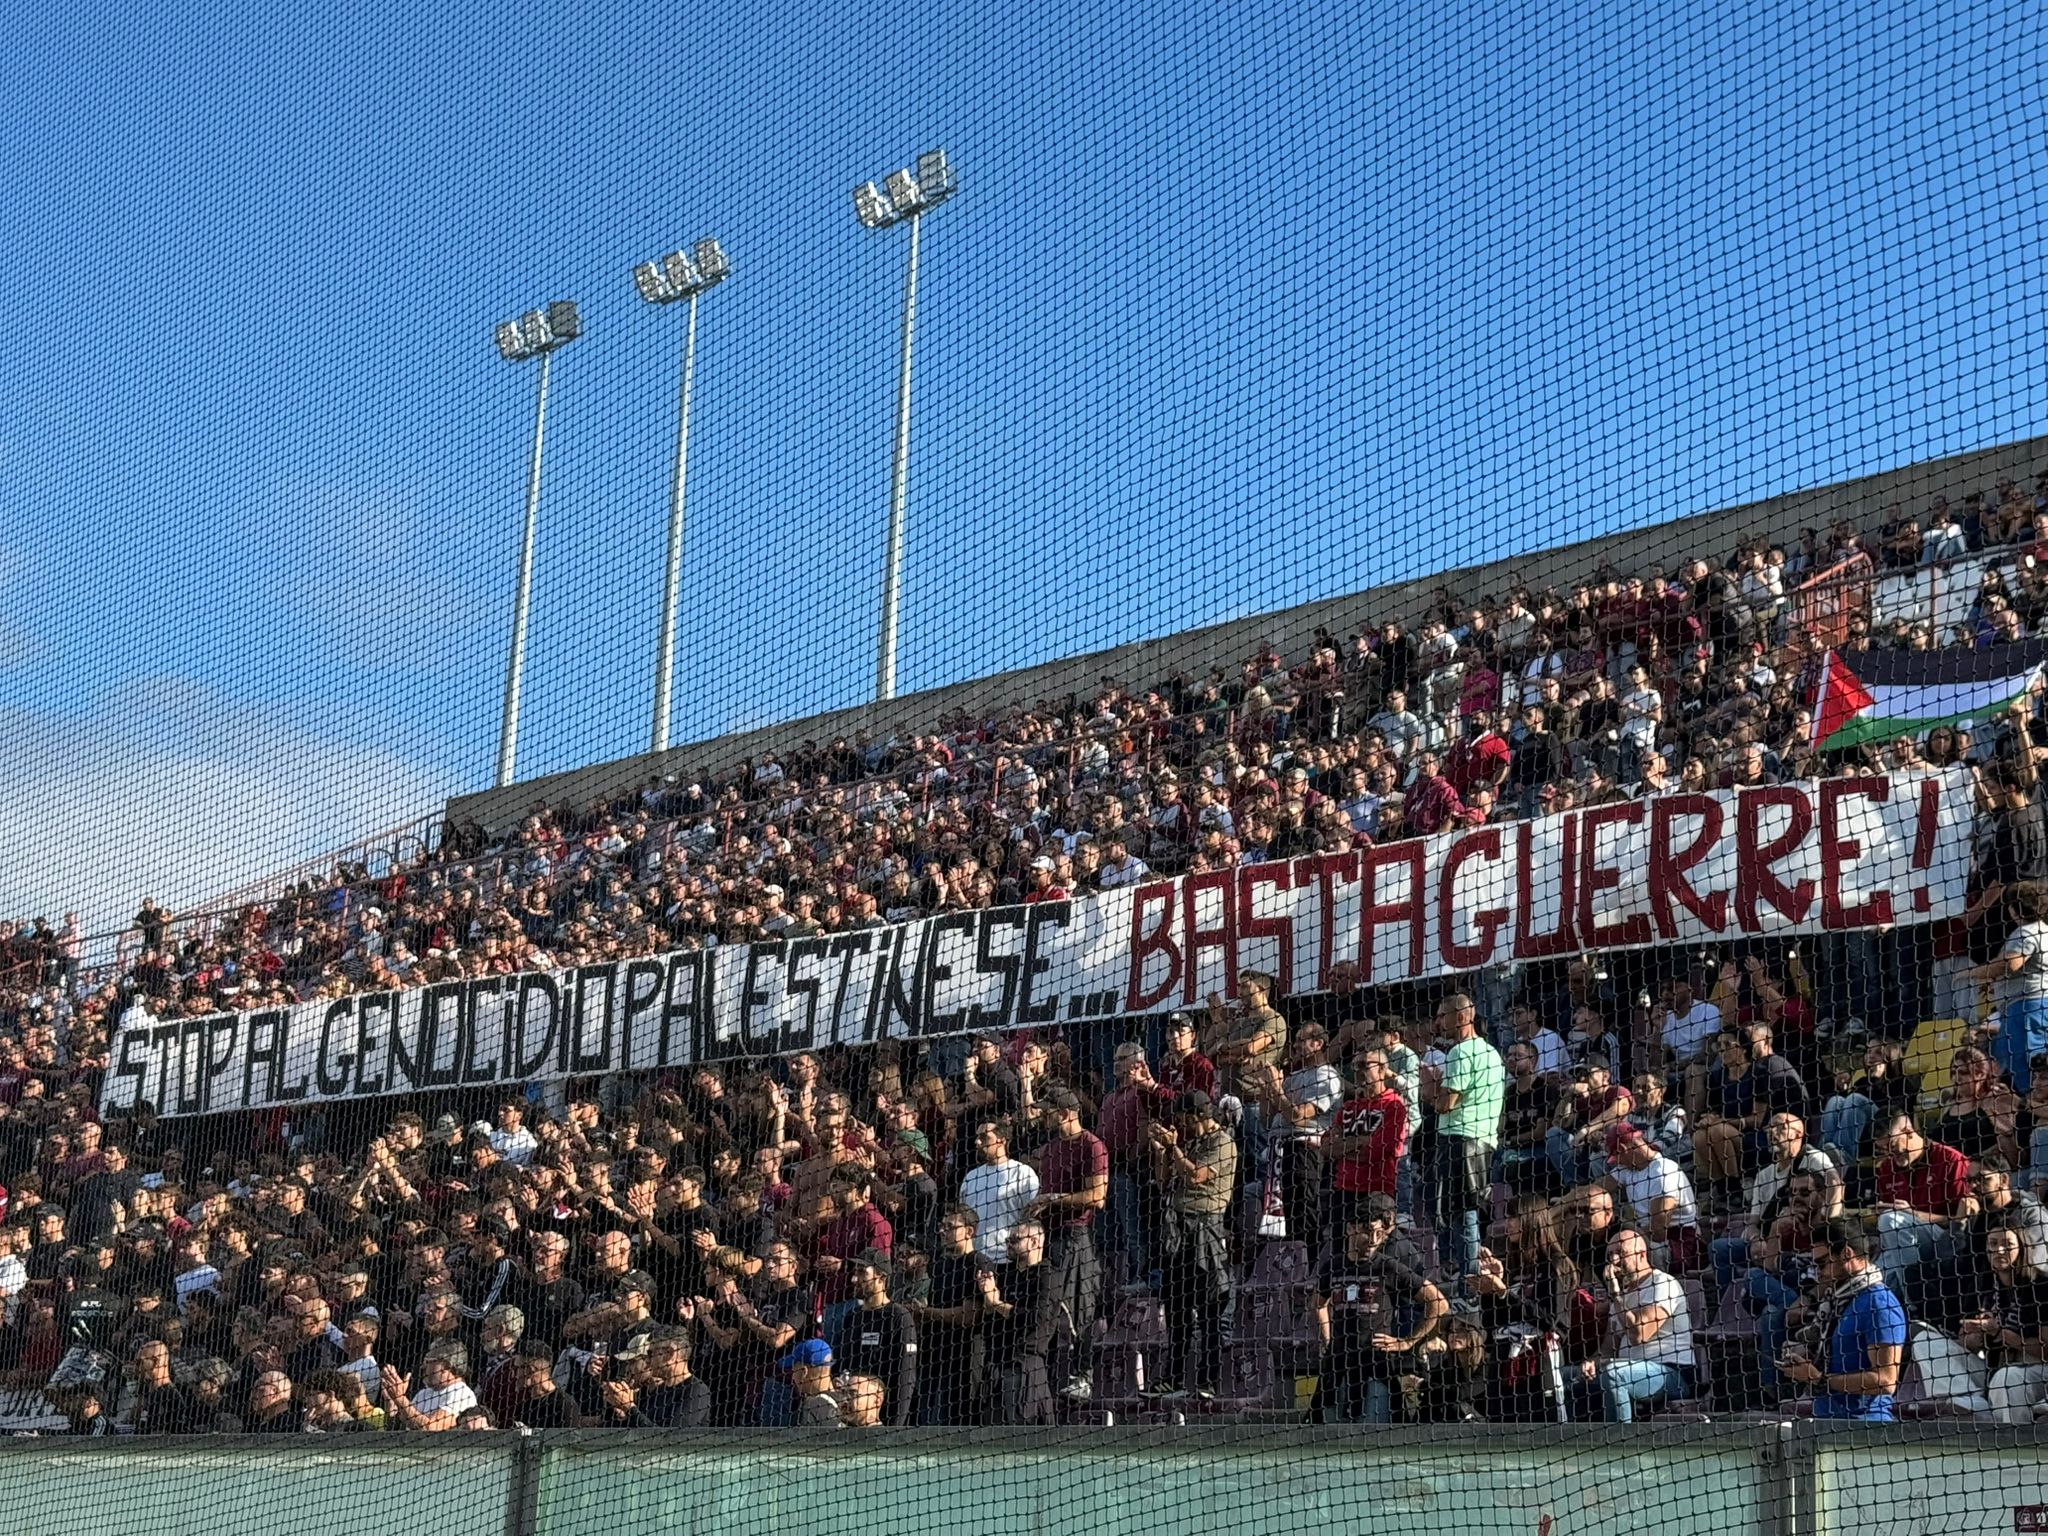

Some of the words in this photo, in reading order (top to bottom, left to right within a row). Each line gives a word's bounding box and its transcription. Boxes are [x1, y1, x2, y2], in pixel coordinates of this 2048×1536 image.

[104, 1014, 238, 1119] STOP
[241, 1009, 309, 1105] AL
[1125, 839, 1425, 1011] BASTA
[1439, 775, 1939, 968] GUERRE!
[1341, 1108, 1384, 1136] EA7
